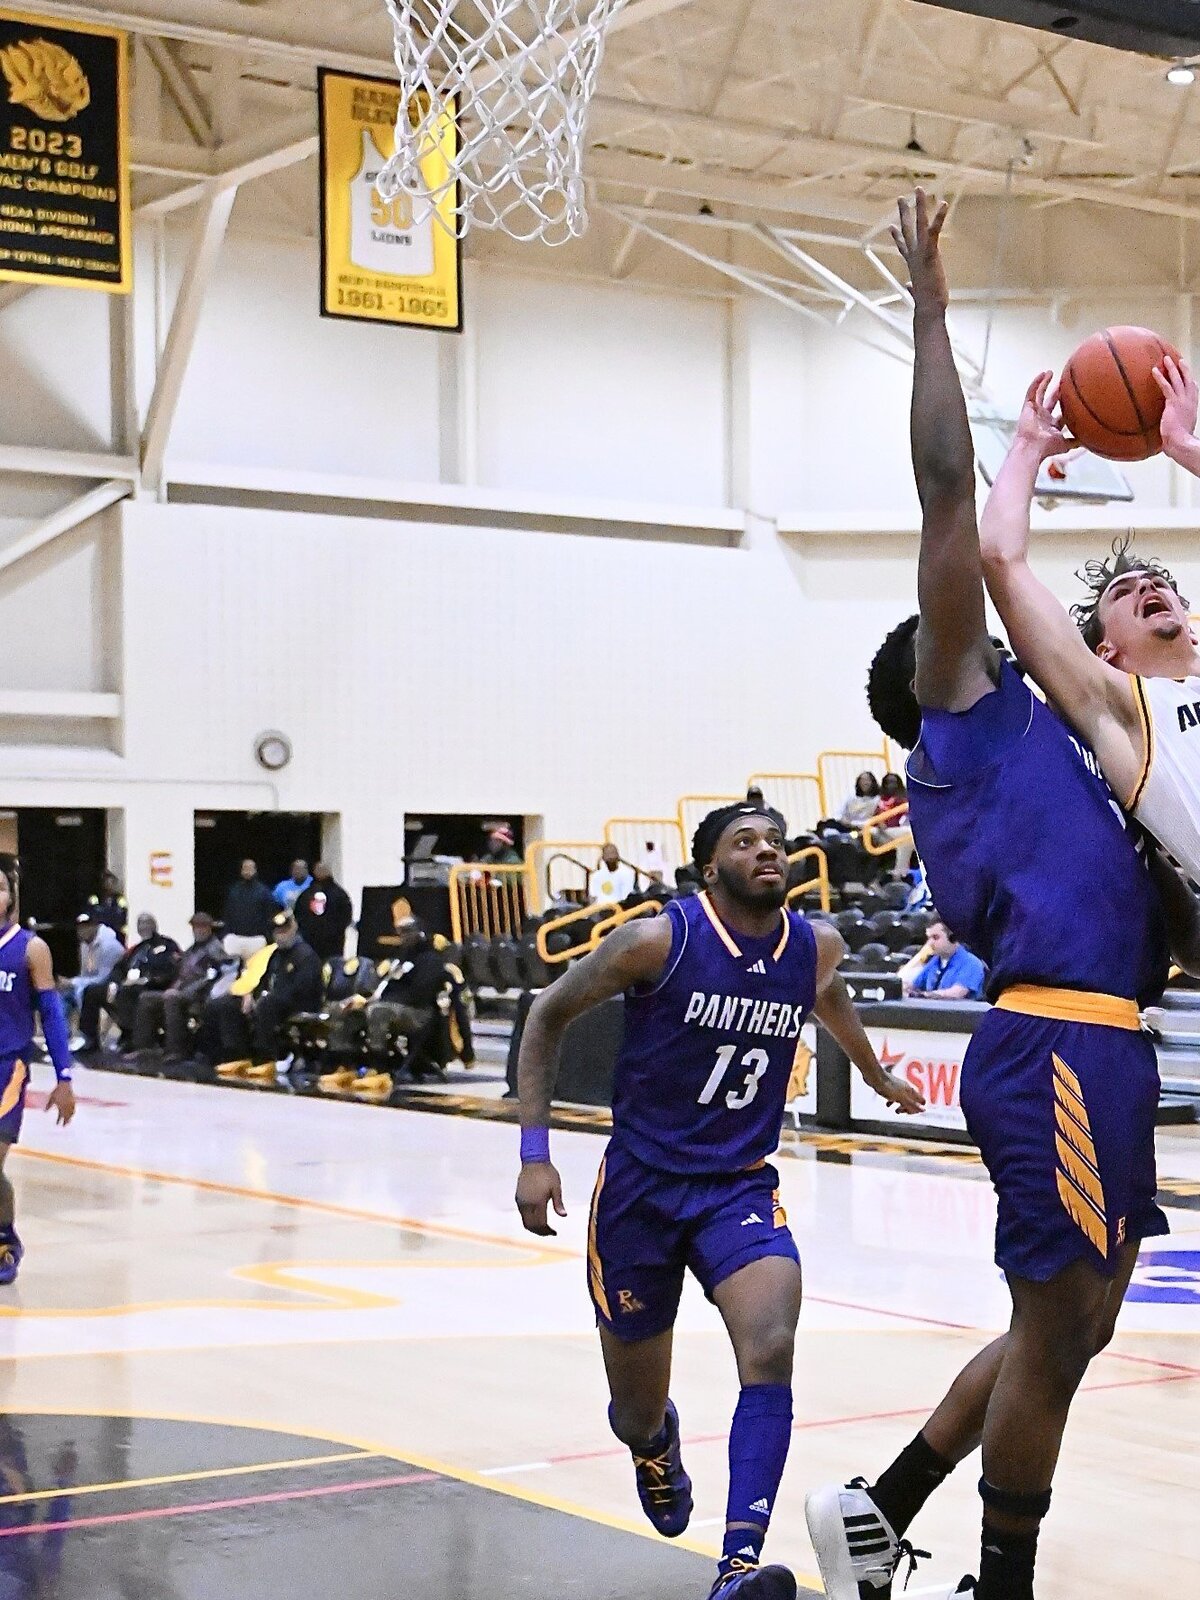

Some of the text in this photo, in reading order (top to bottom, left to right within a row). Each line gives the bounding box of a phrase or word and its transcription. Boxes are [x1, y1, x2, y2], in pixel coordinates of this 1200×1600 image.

[10, 126, 82, 158] 2023
[54, 160, 99, 180] GOLF
[25, 176, 117, 202] CHAMPIONS
[0, 219, 36, 235] IONAL
[35, 208, 89, 225] DIVISION
[683, 991, 803, 1039] PANTHERS
[697, 1044, 770, 1110] 13
[906, 1060, 960, 1107] SW
